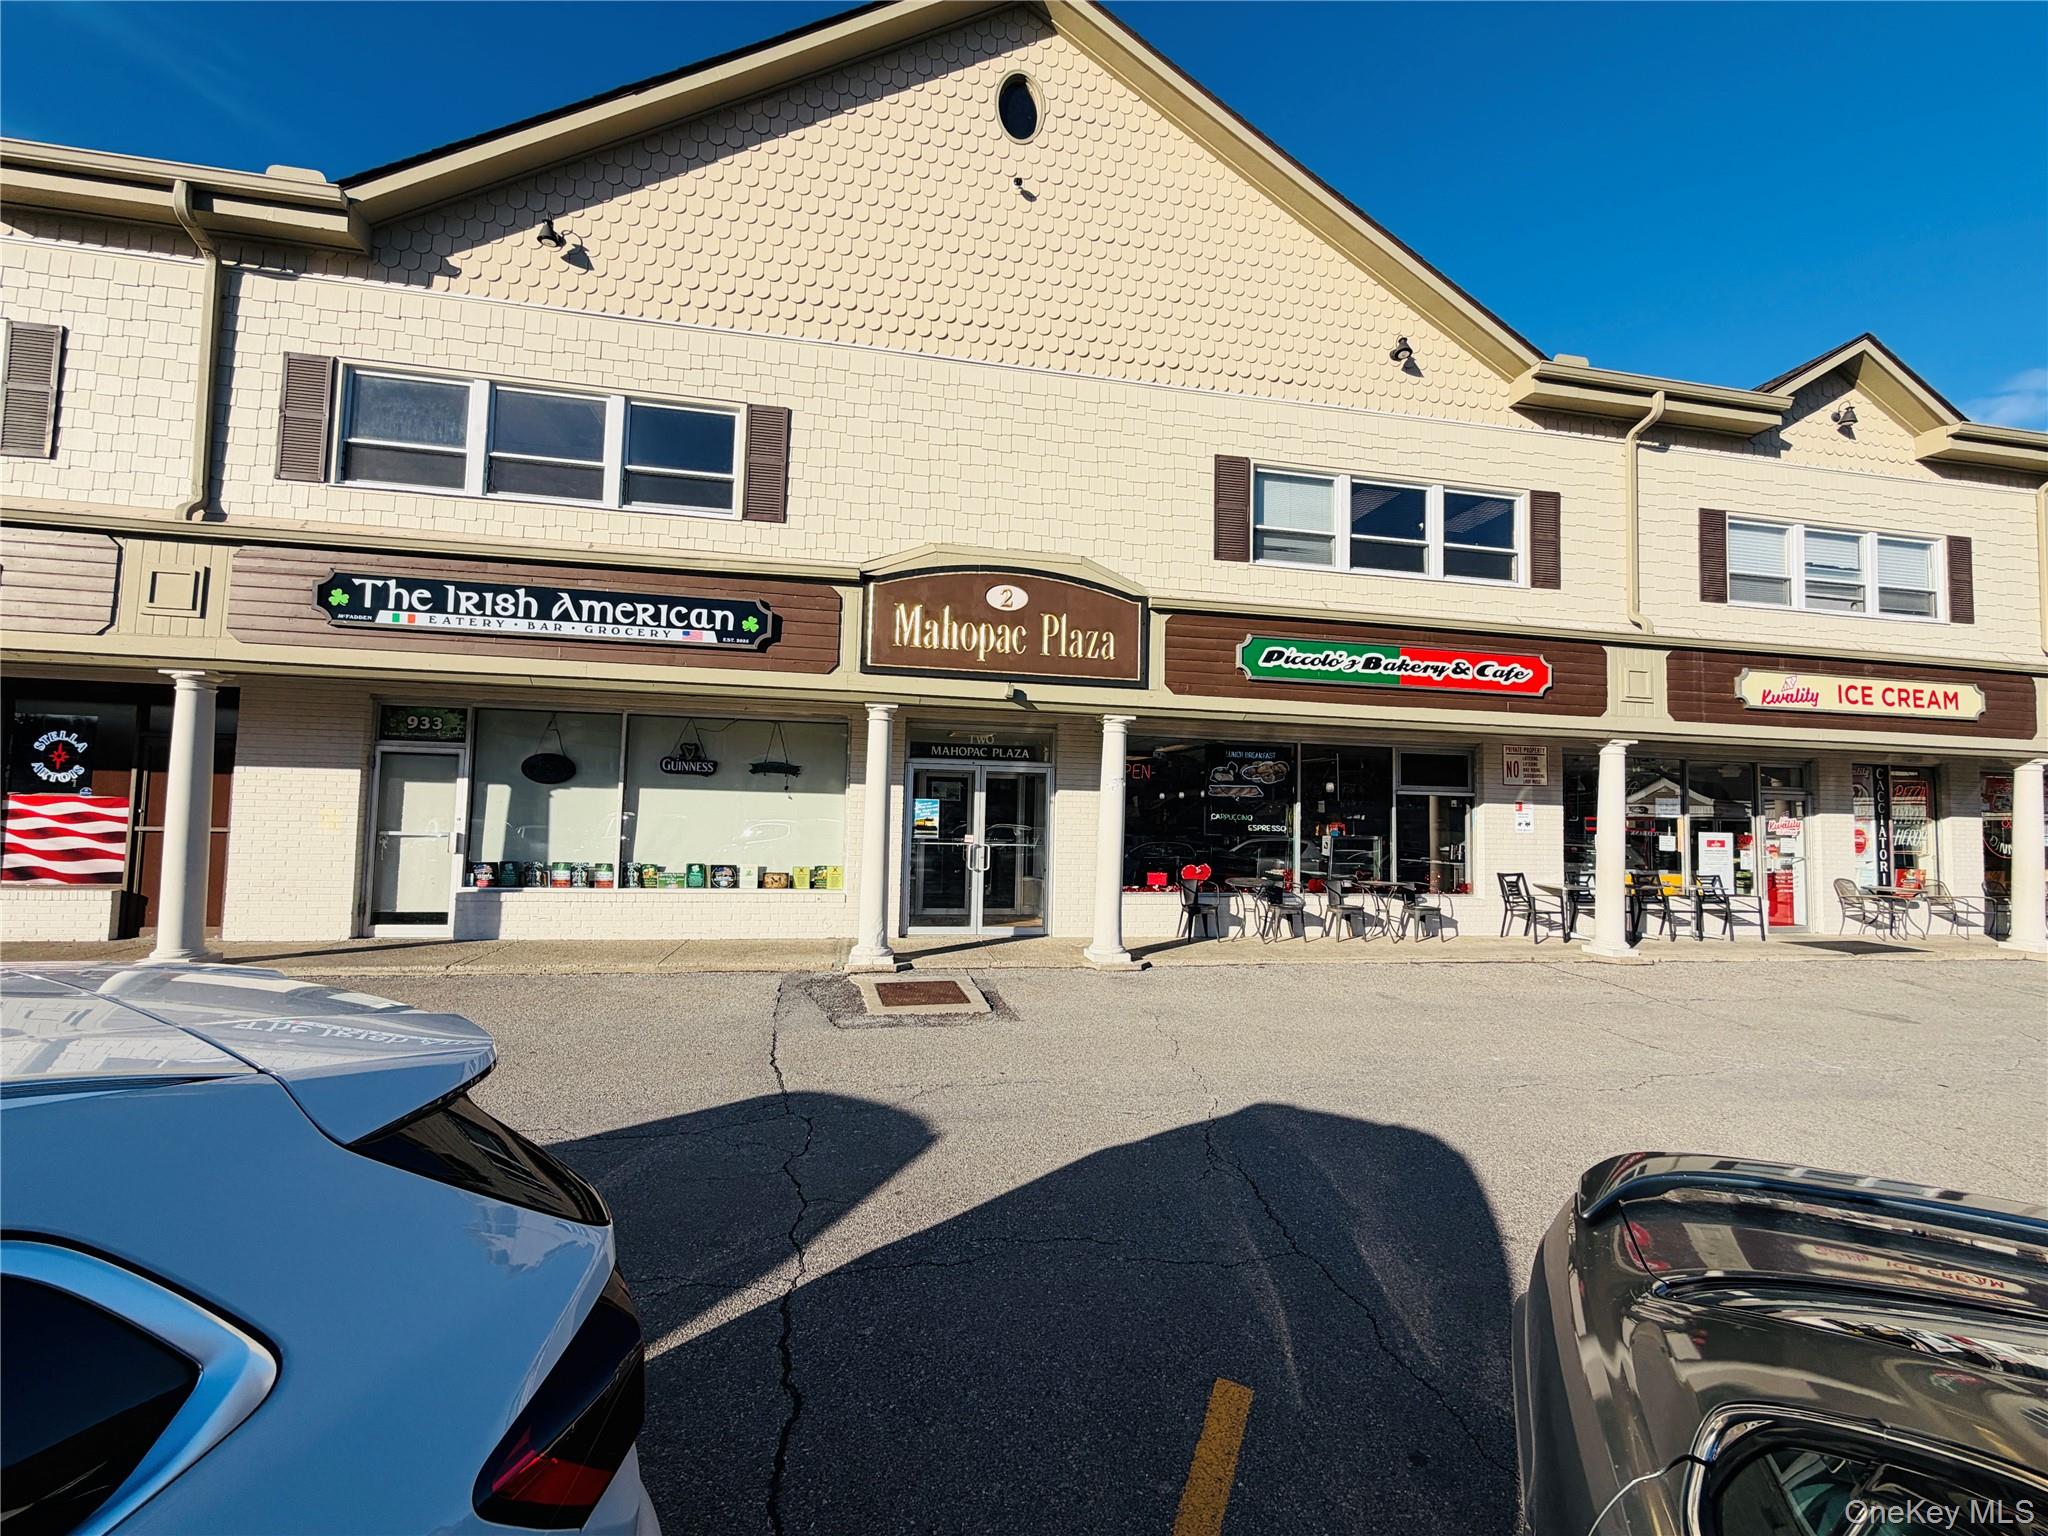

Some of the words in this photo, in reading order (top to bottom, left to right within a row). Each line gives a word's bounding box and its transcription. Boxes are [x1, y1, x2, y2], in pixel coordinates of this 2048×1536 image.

[351, 578, 433, 611] The
[1000, 588, 1014, 608] 2
[429, 615, 505, 628] EATERY
[528, 621, 563, 632] BAR
[585, 625, 672, 638] GROCERY
[892, 602, 1027, 662] Mahopac
[1040, 613, 1117, 661] Plaza
[1362, 656, 1450, 678] Bakery
[1451, 661, 1471, 677] &
[1477, 664, 1531, 683] Cafe
[1761, 687, 1819, 708] Kwality
[1838, 684, 1874, 706] ICE
[1882, 687, 1960, 710] CREAM
[406, 715, 443, 730] 933
[33, 730, 88, 753] STELLA
[969, 735, 995, 744] TWO
[931, 746, 988, 757] MAHOPAC
[992, 748, 1030, 758] PLAZA
[31, 761, 85, 783] ARTOIS
[662, 758, 714, 773] GUINNESS
[1124, 764, 1151, 779] PEN
[1506, 760, 1520, 778] NO
[1210, 813, 1253, 822] CAPPUCCINO
[1876, 768, 1889, 886] CACCIATORI
